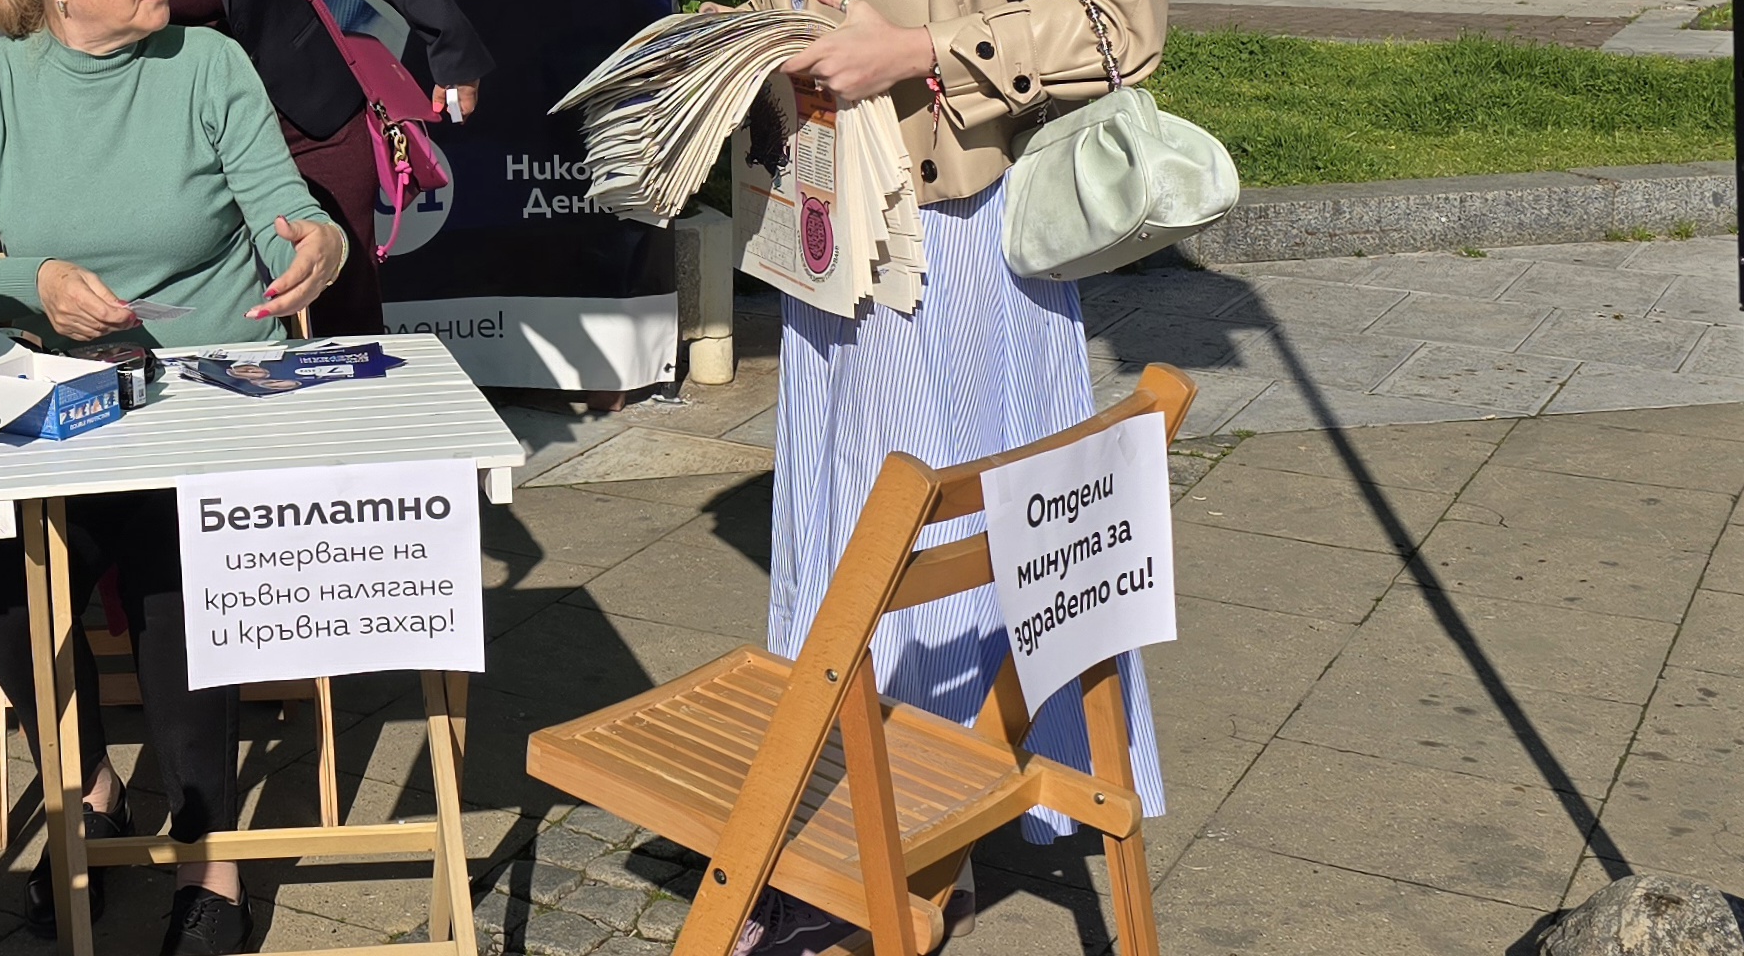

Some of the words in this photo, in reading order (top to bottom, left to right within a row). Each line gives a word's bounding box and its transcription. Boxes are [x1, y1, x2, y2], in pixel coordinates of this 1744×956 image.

[506, 153, 592, 181] Нико
[522, 187, 613, 219] Денк
[199, 495, 451, 533] Безплатно
[1026, 472, 1115, 528] Отдели
[225, 541, 385, 571] измерване
[393, 542, 428, 561] на
[1017, 531, 1103, 590] минута
[1106, 520, 1133, 549] за
[204, 582, 311, 615] кръвно
[319, 578, 454, 601] налягане
[1014, 580, 1111, 656] здравето
[1116, 556, 1155, 596] си!
[211, 629, 228, 648] и
[238, 615, 351, 649] кръвна
[359, 608, 455, 636] захар!
